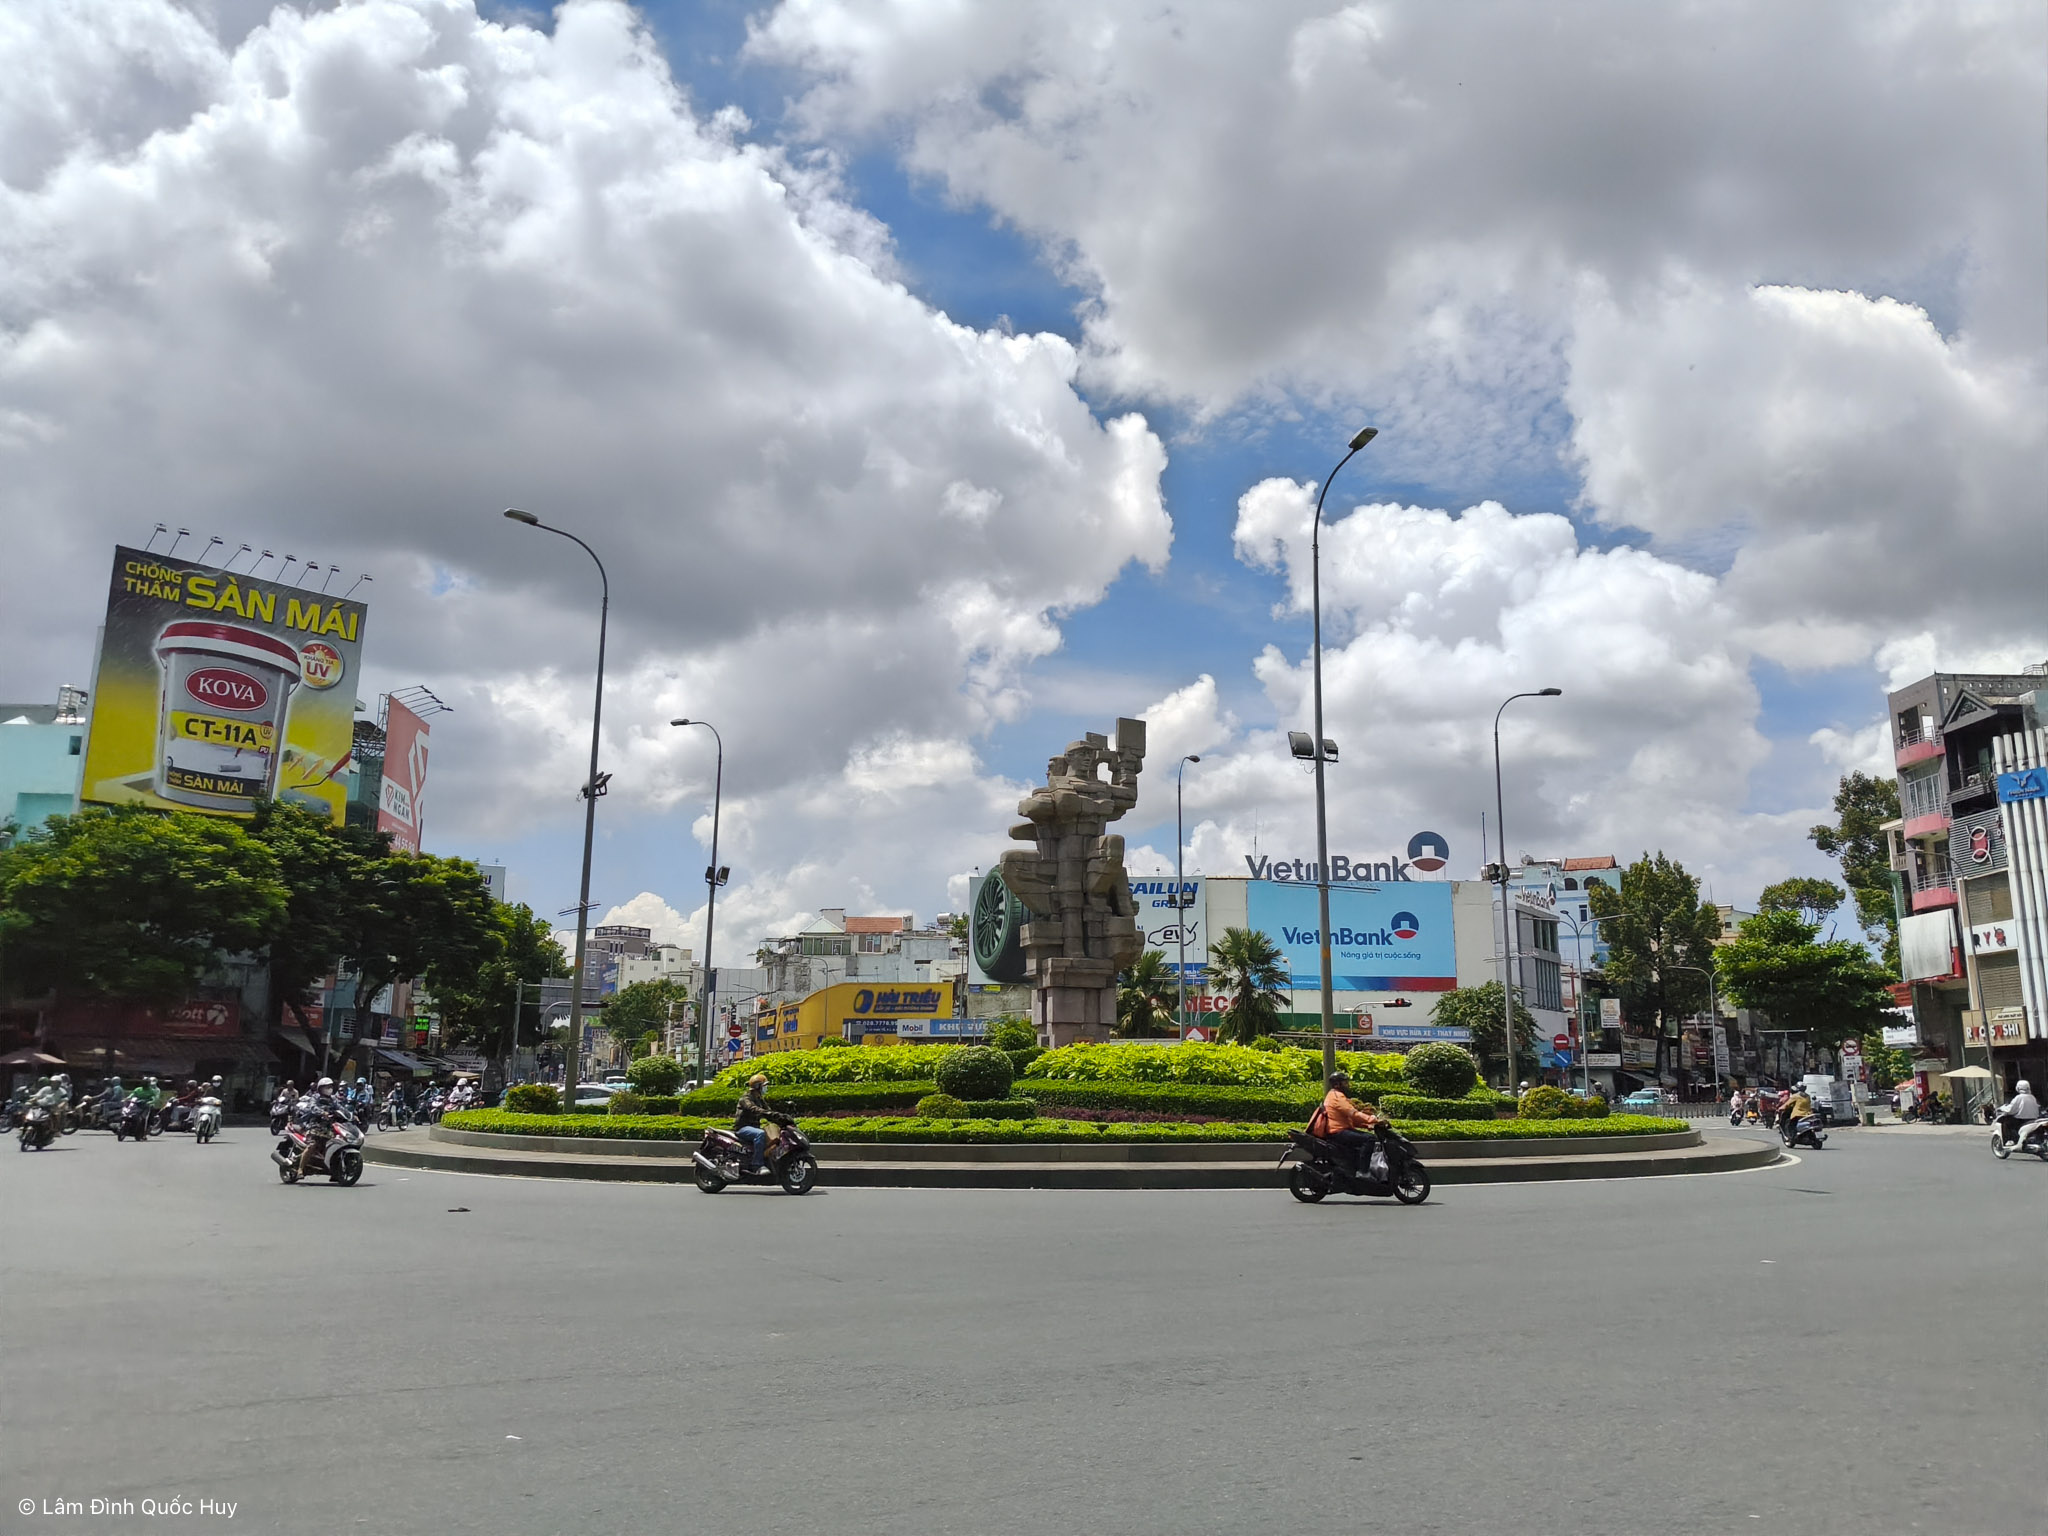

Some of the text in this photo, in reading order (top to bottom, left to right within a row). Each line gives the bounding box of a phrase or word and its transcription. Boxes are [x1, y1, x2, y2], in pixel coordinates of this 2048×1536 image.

[125, 561, 182, 584] CHỐNG
[125, 577, 181, 602] THẤM
[186, 575, 358, 642] SÀN MÁI
[307, 661, 331, 677] UV
[198, 677, 256, 702] KOVA
[185, 718, 257, 745] CT-11A
[184, 774, 213, 790] SÀN
[217, 781, 243, 793] MÁI
[1281, 926, 1393, 945] VietnBank
[1341, 951, 1360, 960] Nâng
[1362, 951, 1374, 960] giá
[1384, 951, 1401, 960] cuộc
[1402, 951, 1421, 960] sống
[1396, 1028, 1409, 1036] VỰC
